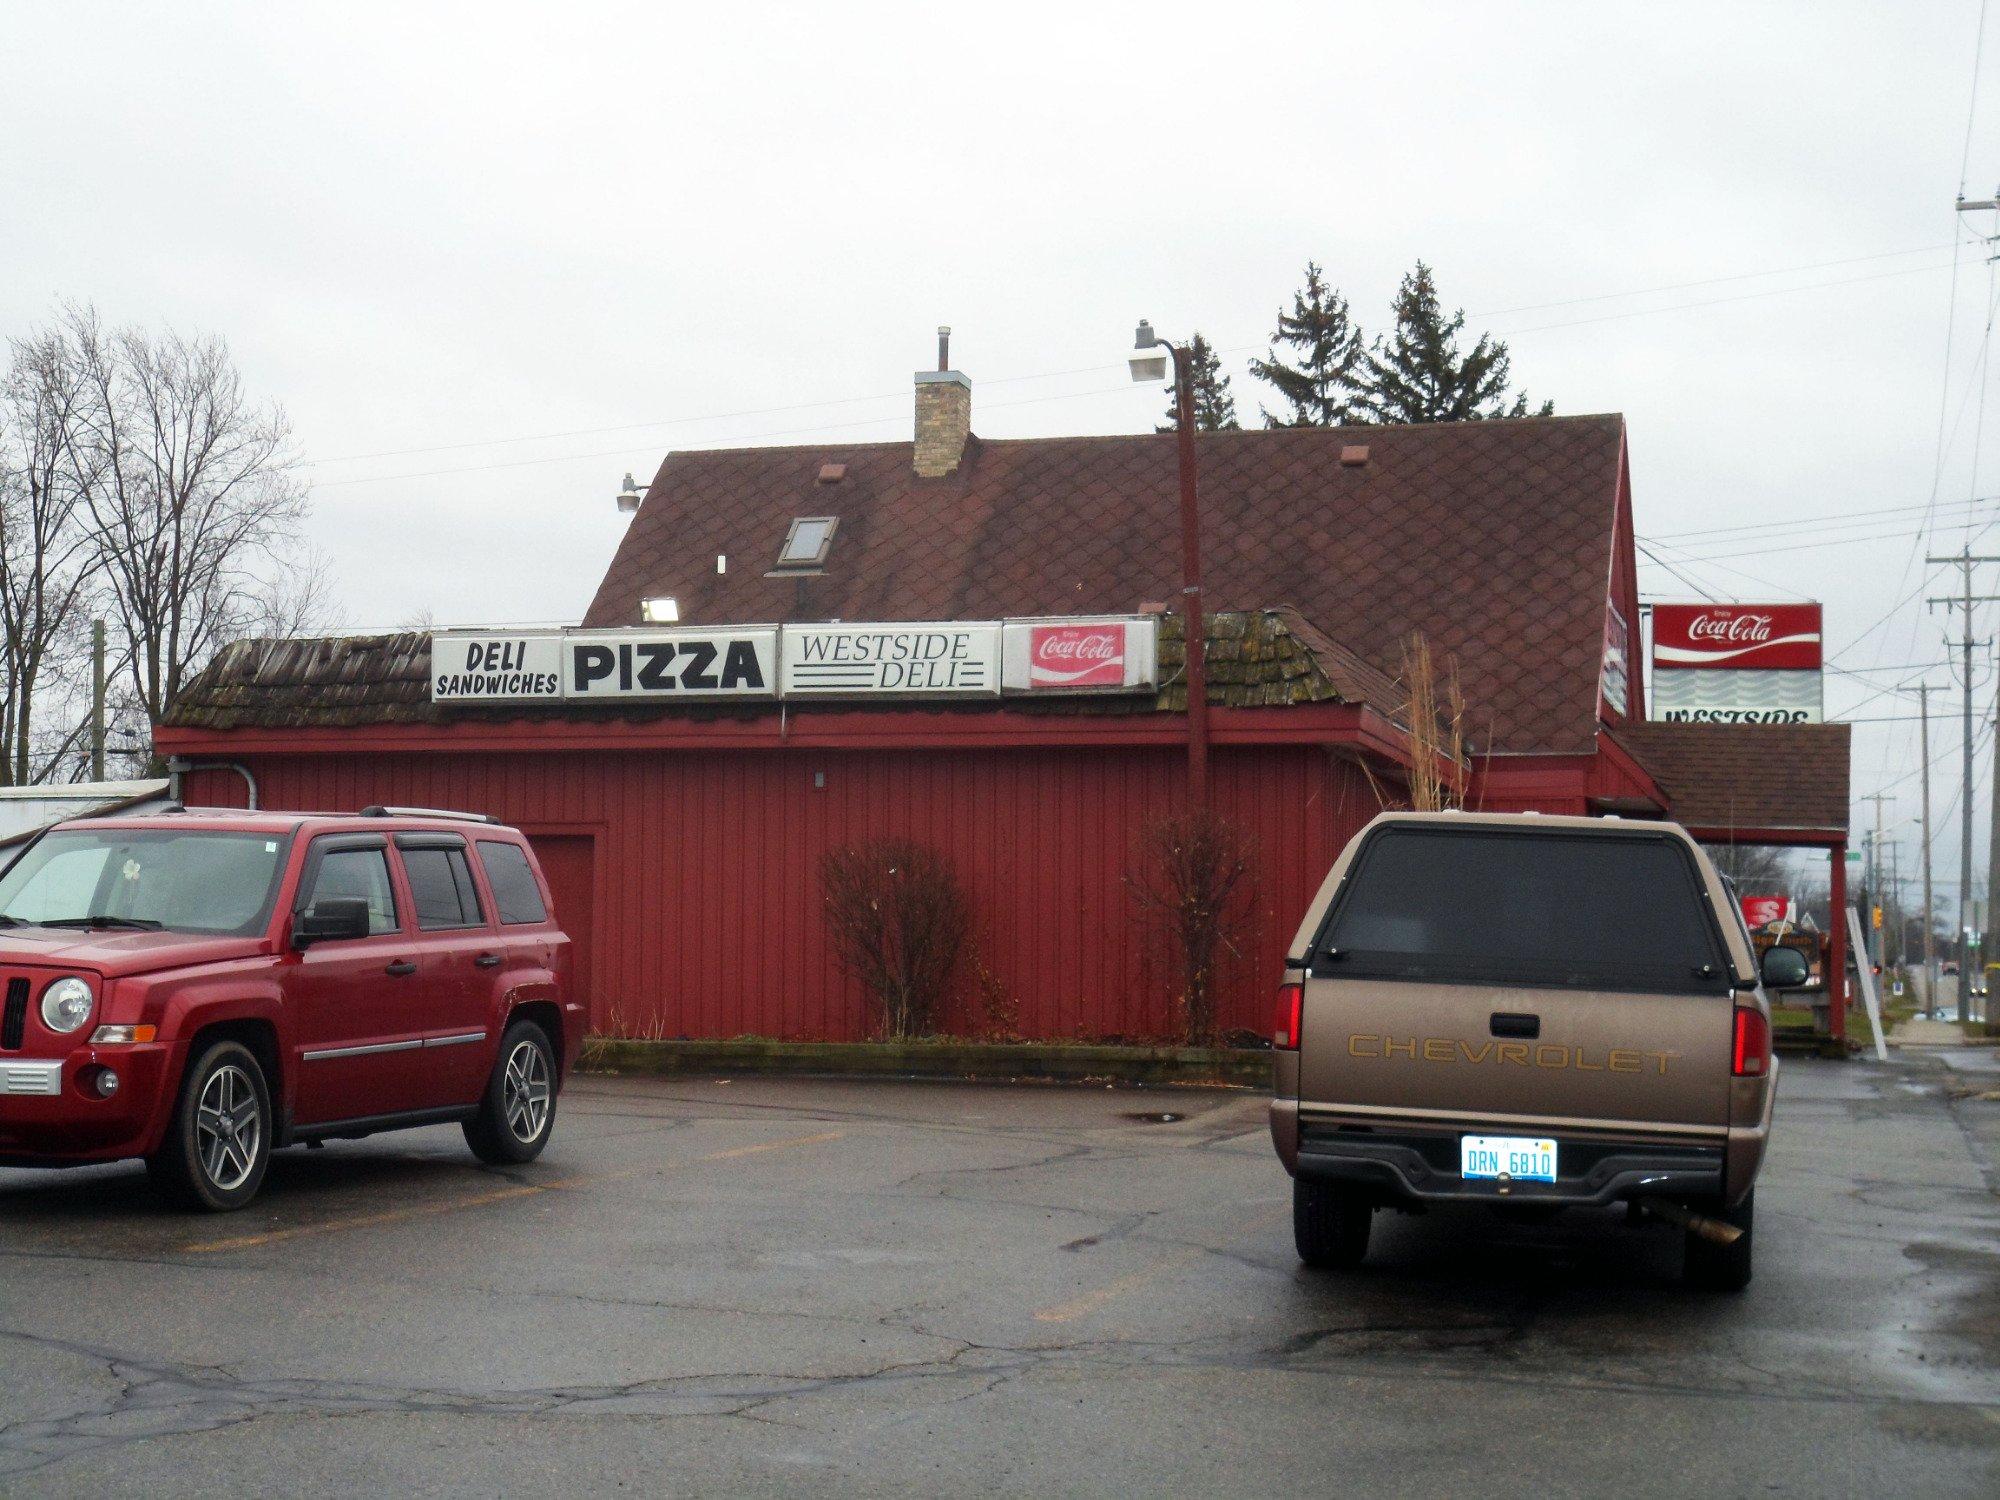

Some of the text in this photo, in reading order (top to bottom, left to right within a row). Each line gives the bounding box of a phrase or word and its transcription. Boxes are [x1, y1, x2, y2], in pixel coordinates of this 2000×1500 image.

[1688, 615, 1772, 641] Coca-Cola
[466, 641, 527, 672] DELI
[801, 634, 970, 661] WESTSIDE
[1040, 635, 1116, 659] Coca-Cola
[573, 640, 766, 691] PIZZA
[878, 661, 960, 689] DELI
[436, 672, 558, 695] SANDWICHES
[1347, 1033, 1683, 1075] CHEVROLET
[1468, 1150, 1551, 1174] DRN 6810
